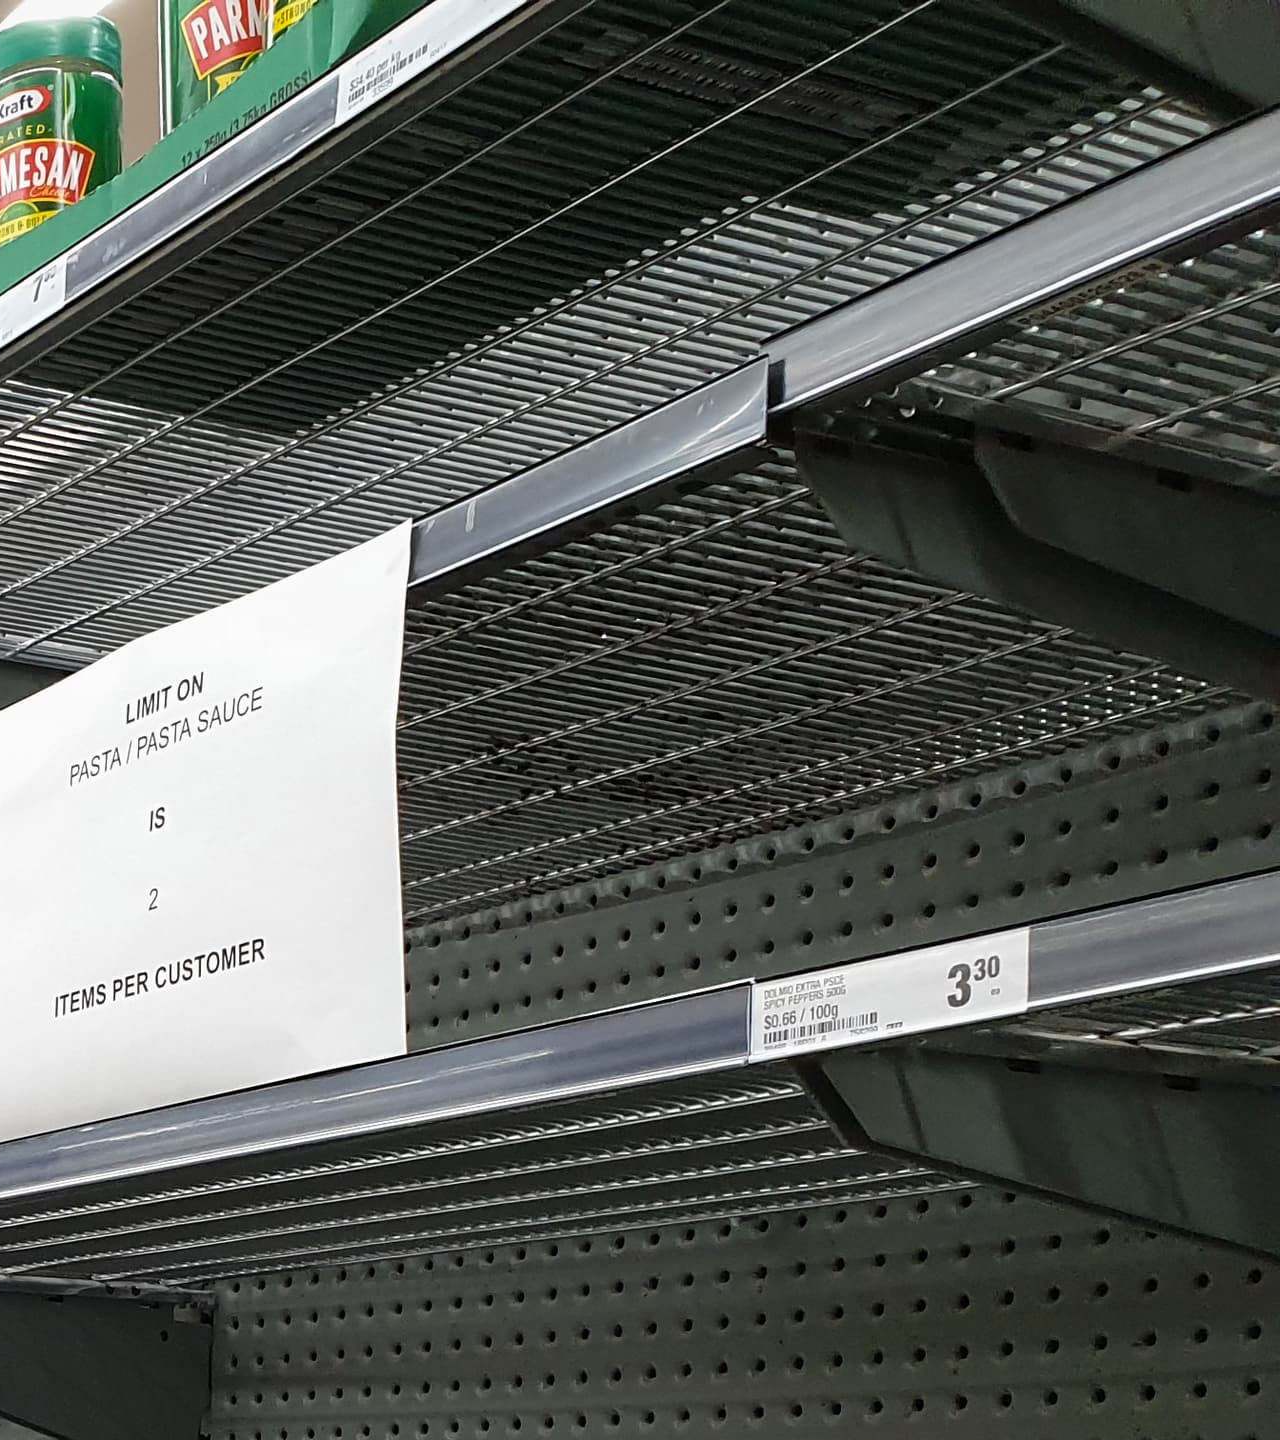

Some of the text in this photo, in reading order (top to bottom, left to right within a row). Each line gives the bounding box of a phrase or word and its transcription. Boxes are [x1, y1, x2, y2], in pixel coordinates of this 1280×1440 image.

[125, 672, 205, 725] LIMIT ON
[69, 686, 265, 787] PASTA / PASTA SAUCE
[149, 807, 166, 832] IS
[148, 888, 159, 912] 2
[54, 938, 266, 1018] ITEMS PER CUSTOMER
[764, 985, 793, 1000] DOLMIO
[796, 981, 821, 993] EXTRA
[788, 990, 823, 1005] PEPPERS
[764, 1011, 796, 1029] $0.66
[810, 1004, 838, 1020] 100g
